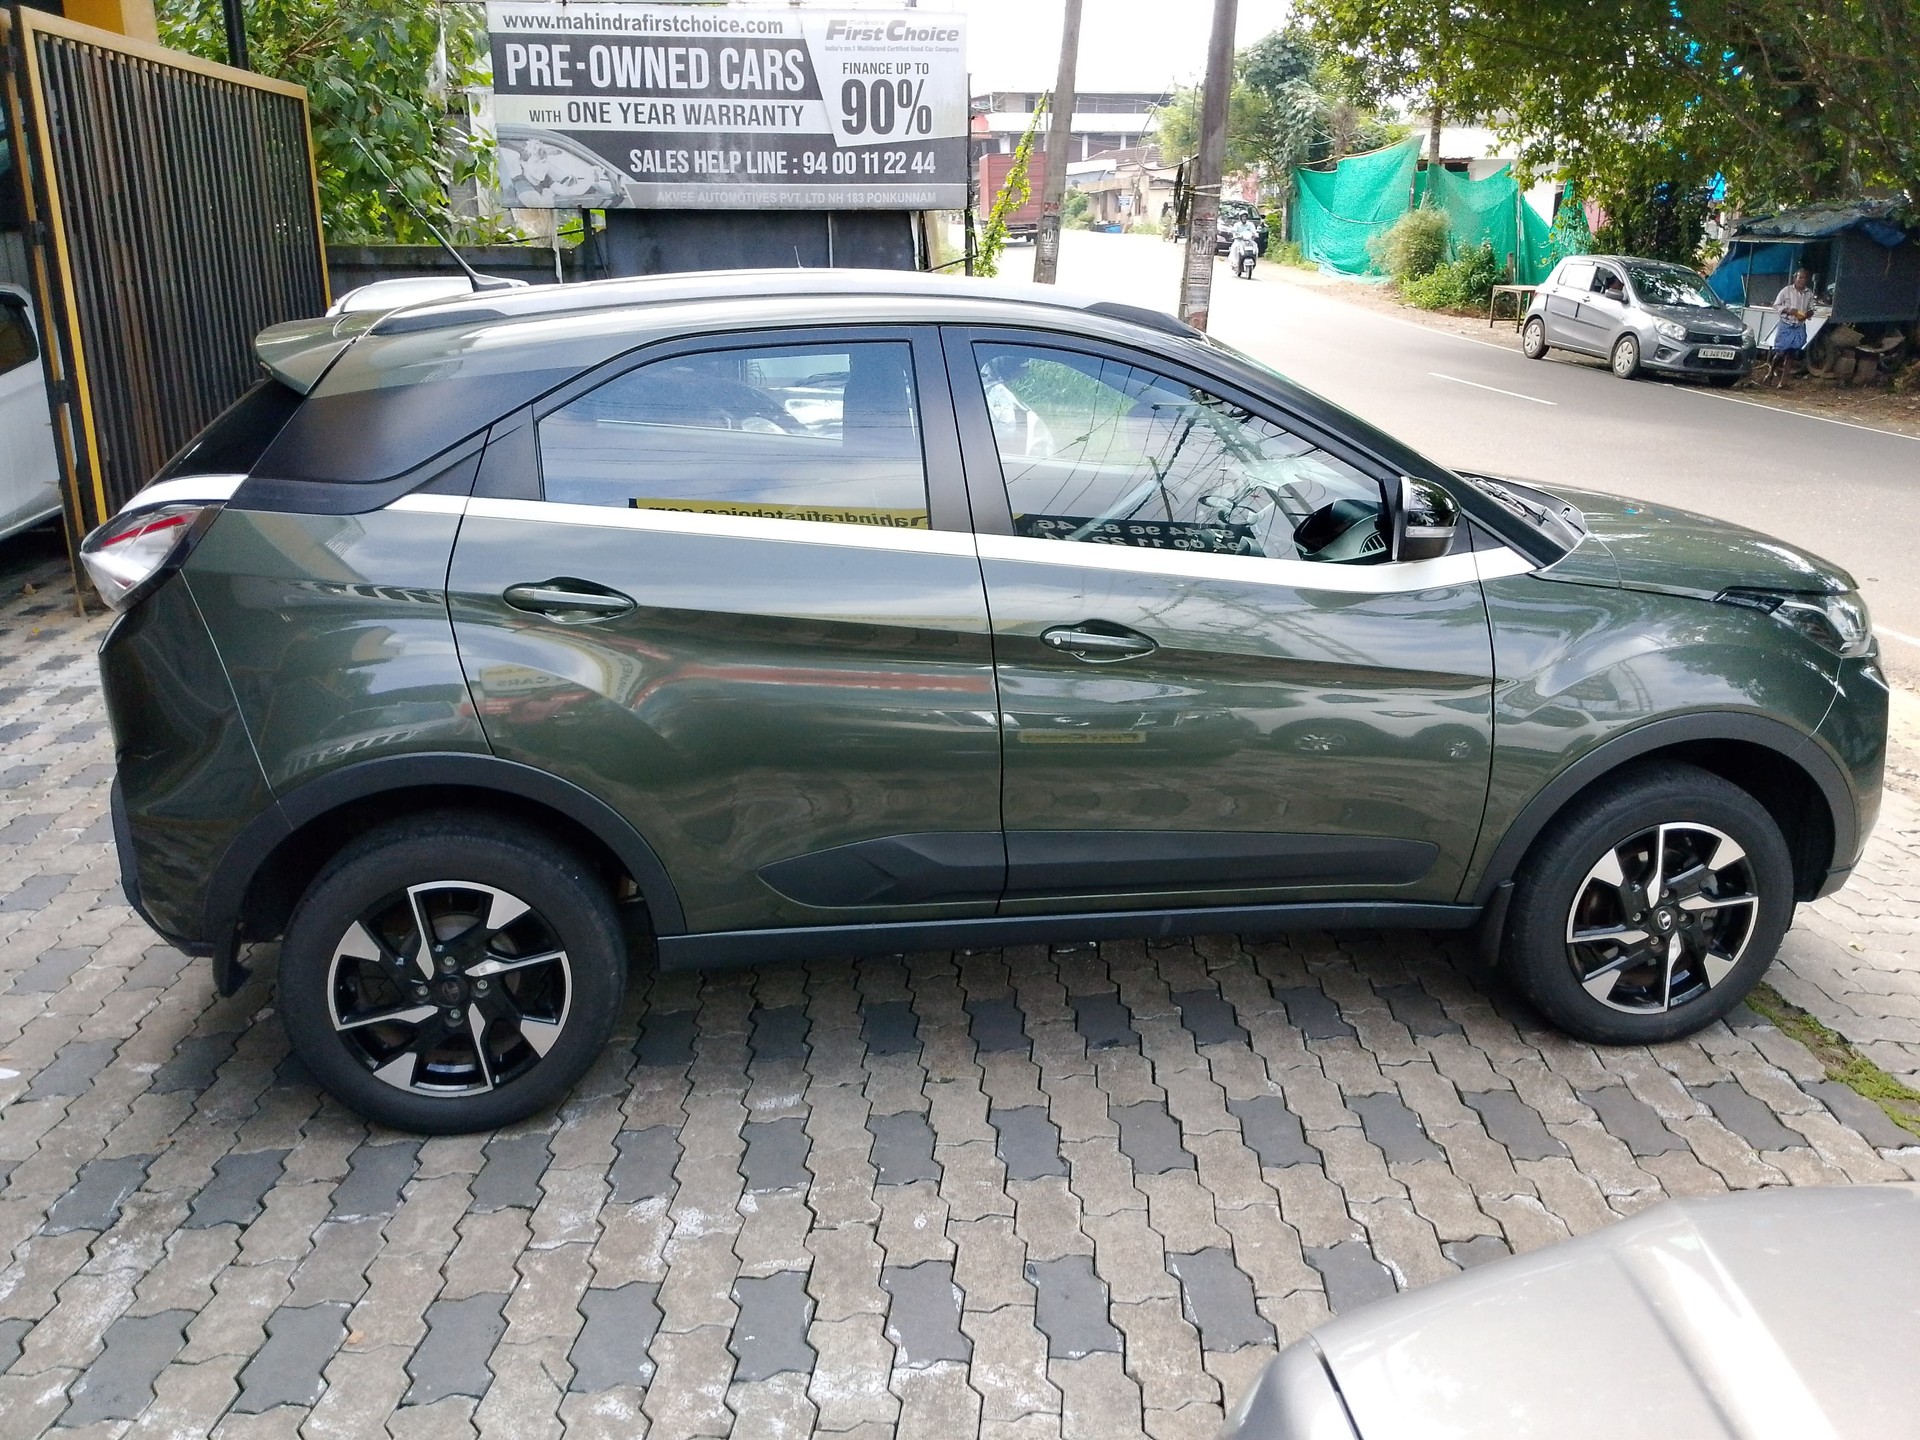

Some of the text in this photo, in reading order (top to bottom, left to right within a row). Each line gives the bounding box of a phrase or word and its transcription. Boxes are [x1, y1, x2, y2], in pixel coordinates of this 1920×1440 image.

[503, 13, 783, 34] www.mahindrafirstchoice.com
[825, 20, 959, 41] First Choice
[719, 47, 805, 91] CARS
[842, 62, 929, 75] FINANCE UP TO
[529, 101, 804, 127] WITH ONE YEAR WARRANTY
[841, 79, 932, 136] 90%
[630, 149, 689, 173] SALES
[694, 150, 741, 174] HELP
[747, 151, 788, 174] LINE
[802, 151, 828, 174] 94
[832, 151, 857, 174] 00
[861, 151, 879, 174] 11
[884, 151, 907, 174] 22
[911, 151, 936, 174] 44
[698, 192, 778, 204] AUTOMOTIVES
[805, 192, 826, 204] LTD
[828, 193, 844, 204] NH
[847, 193, 864, 203] 183
[867, 192, 936, 203] PONKUNNAM
